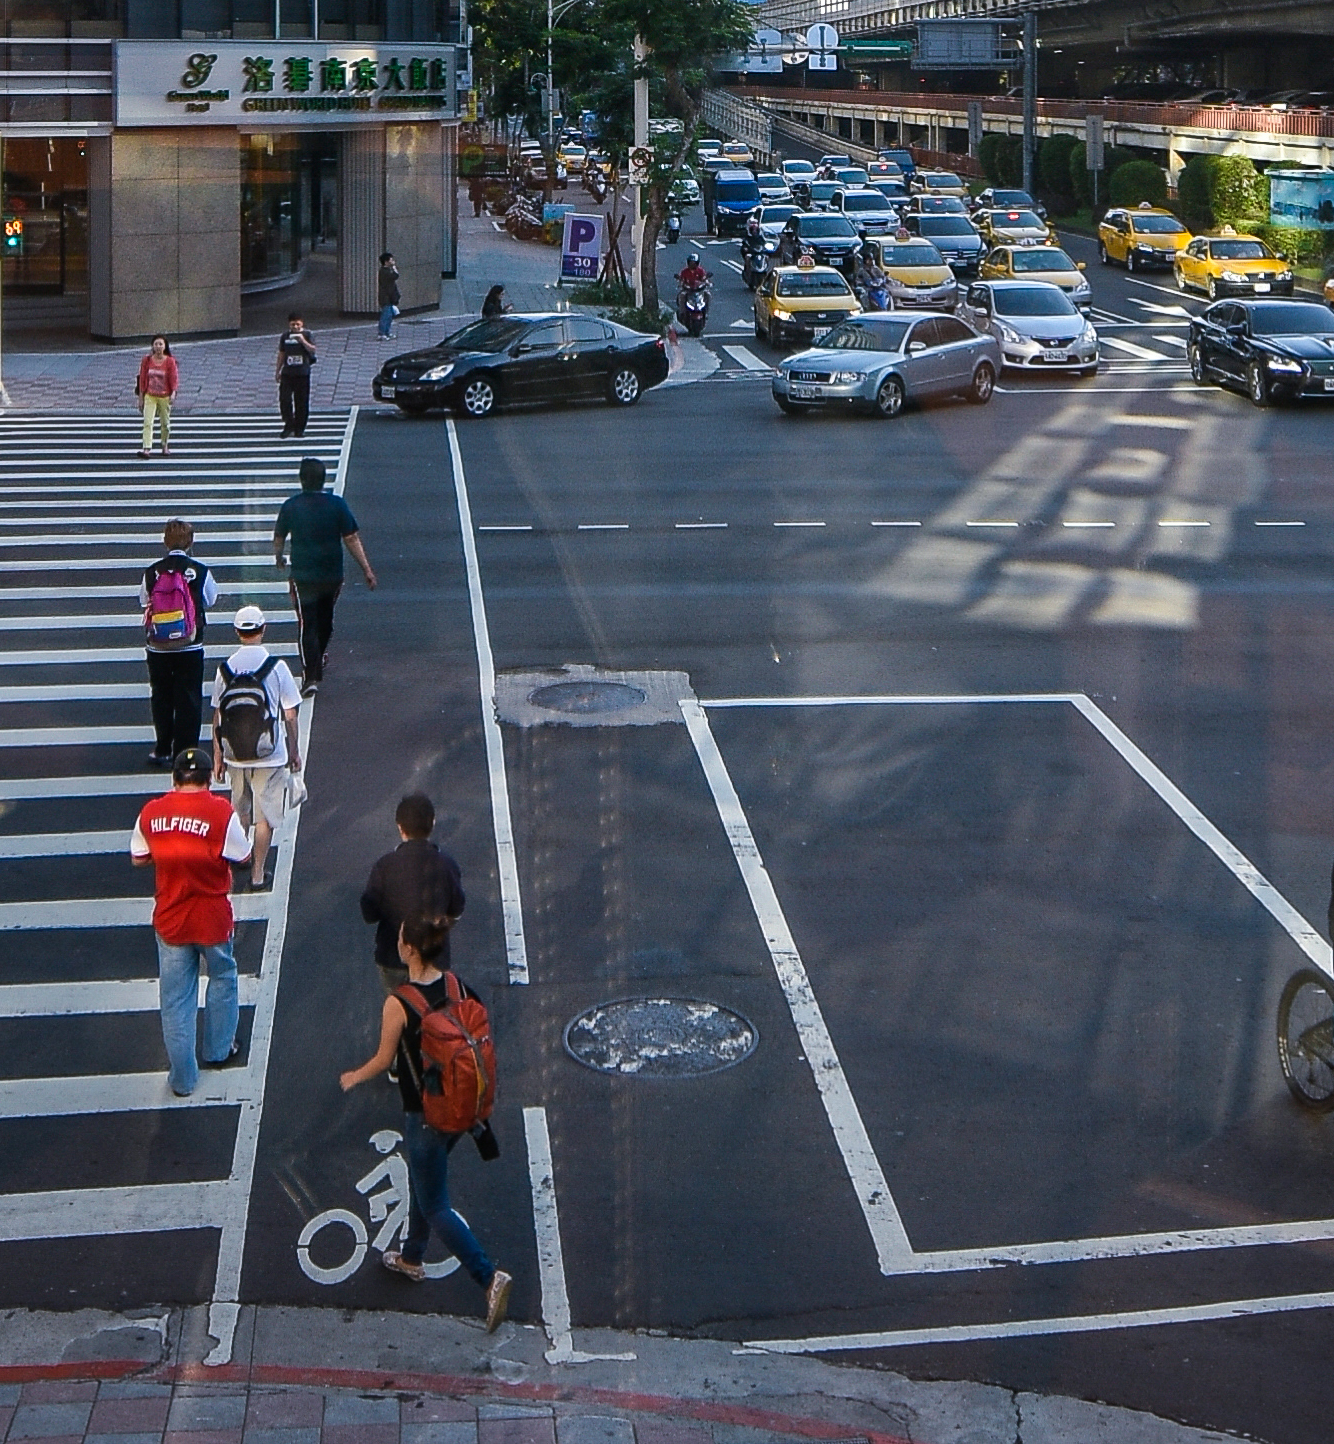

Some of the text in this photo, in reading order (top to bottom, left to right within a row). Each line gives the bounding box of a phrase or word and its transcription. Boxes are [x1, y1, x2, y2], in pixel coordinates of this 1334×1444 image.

[244, 55, 447, 94] 洛碁南京大飯店
[570, 219, 596, 252] P
[573, 257, 591, 268] 30
[150, 816, 211, 838] HILFIGER
